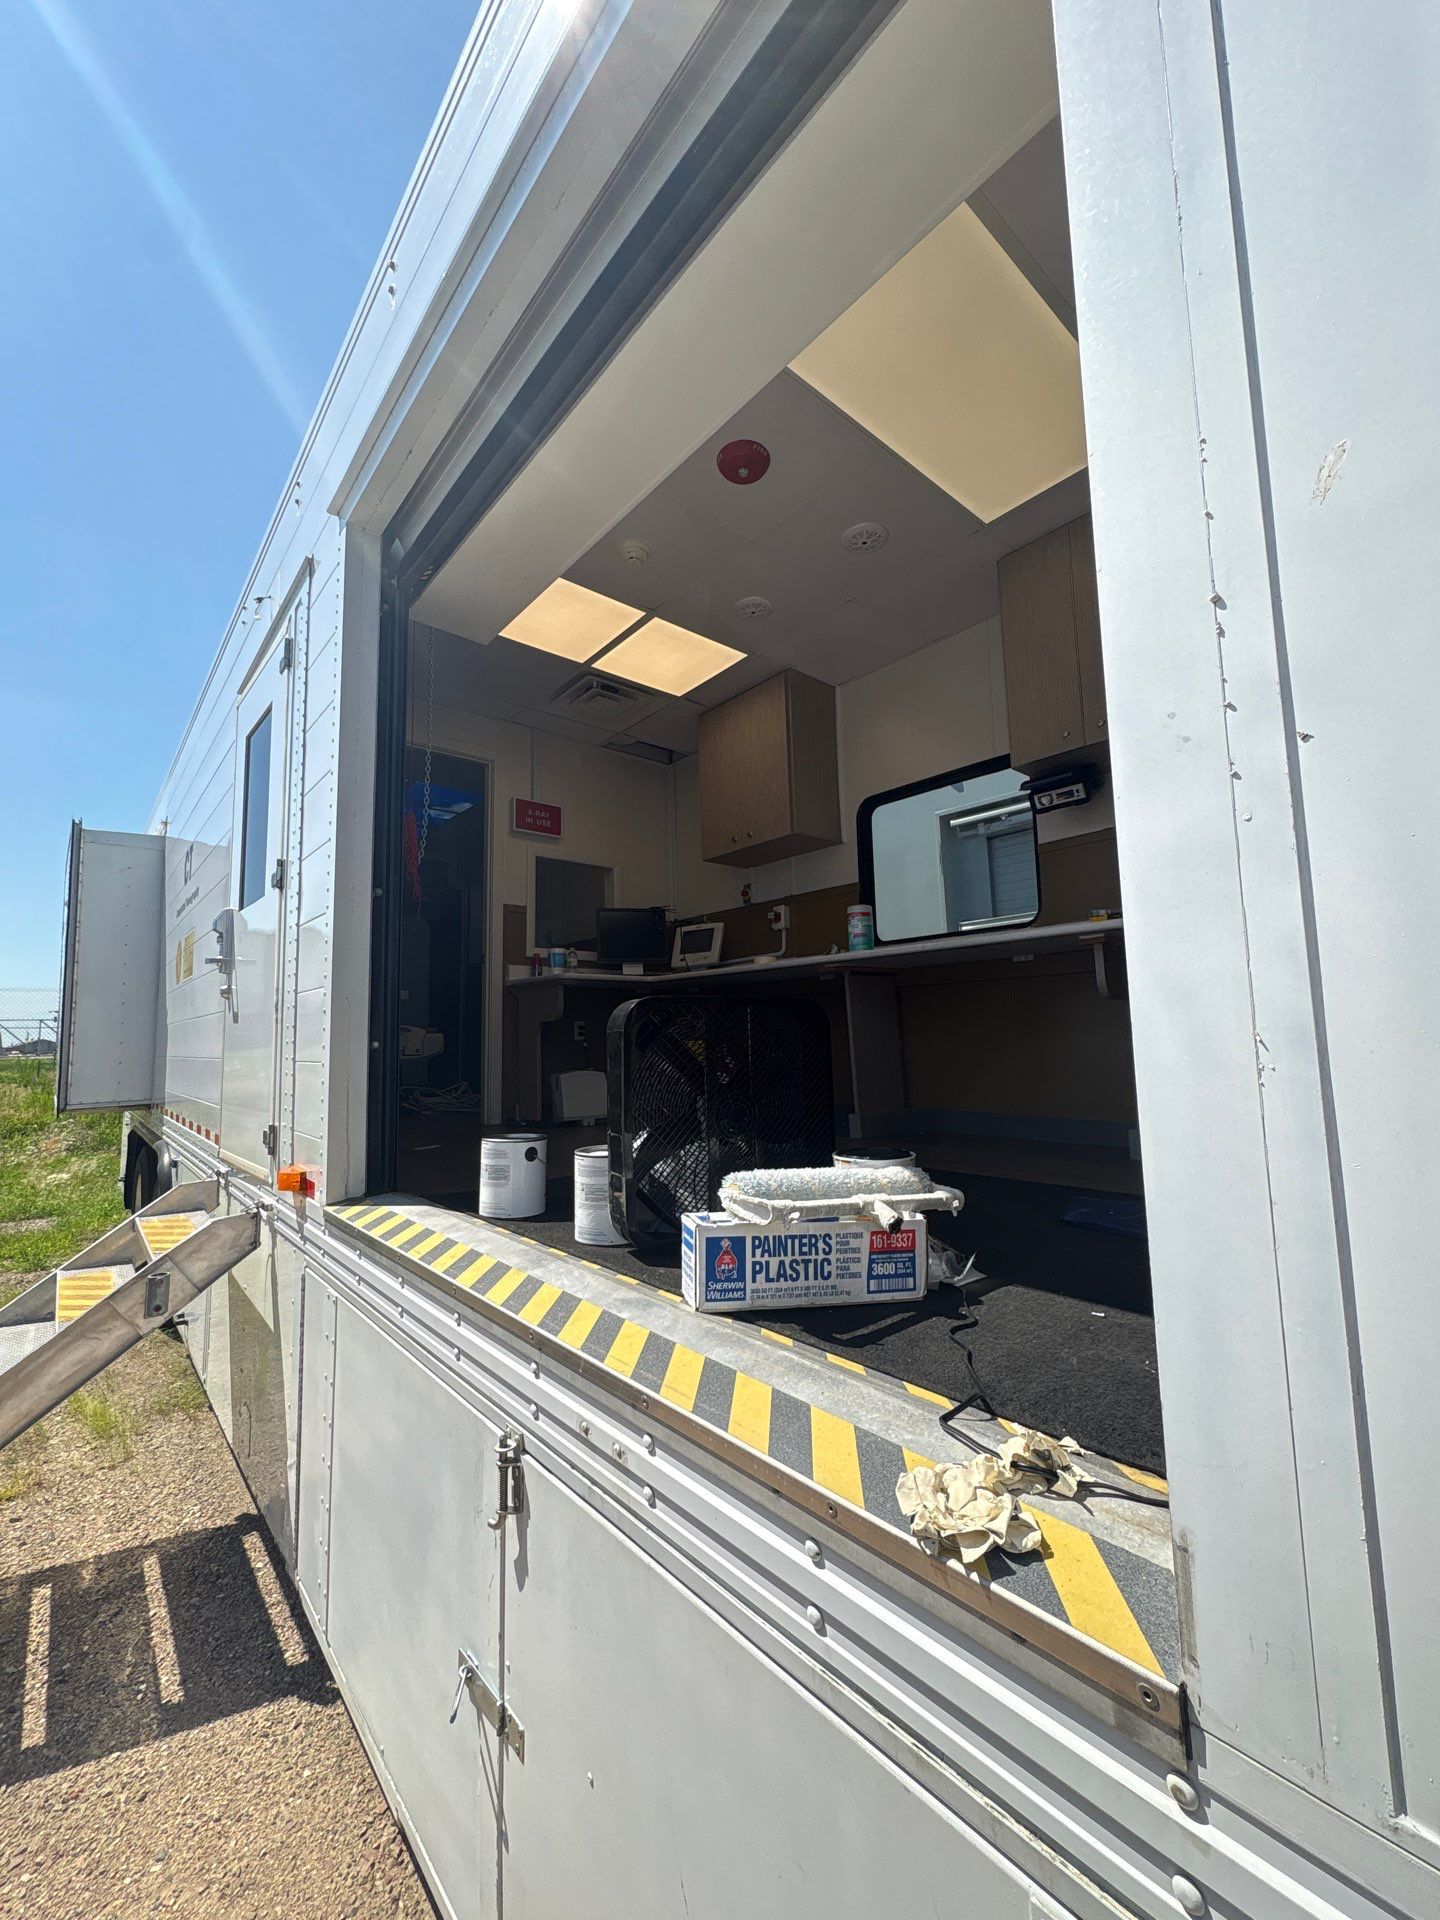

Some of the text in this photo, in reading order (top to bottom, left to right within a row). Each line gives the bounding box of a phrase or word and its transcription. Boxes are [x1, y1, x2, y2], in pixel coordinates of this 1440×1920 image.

[528, 809, 550, 818] X-RAY
[536, 818, 552, 827] USE
[184, 843, 194, 886] CT
[835, 1231, 864, 1240] PLASTIQUE
[871, 1232, 913, 1249] 161-9337
[751, 1233, 833, 1258] PAINTER'S
[835, 1247, 862, 1255] PEINTRES
[835, 1256, 862, 1265] PLÁSTICO
[751, 1257, 832, 1284] PLASTIC
[871, 1262, 896, 1276] 3600
[835, 1272, 862, 1280] PINTORES
[707, 1280, 745, 1291] SHERWIN
[706, 1290, 745, 1300] WILLIAMS
